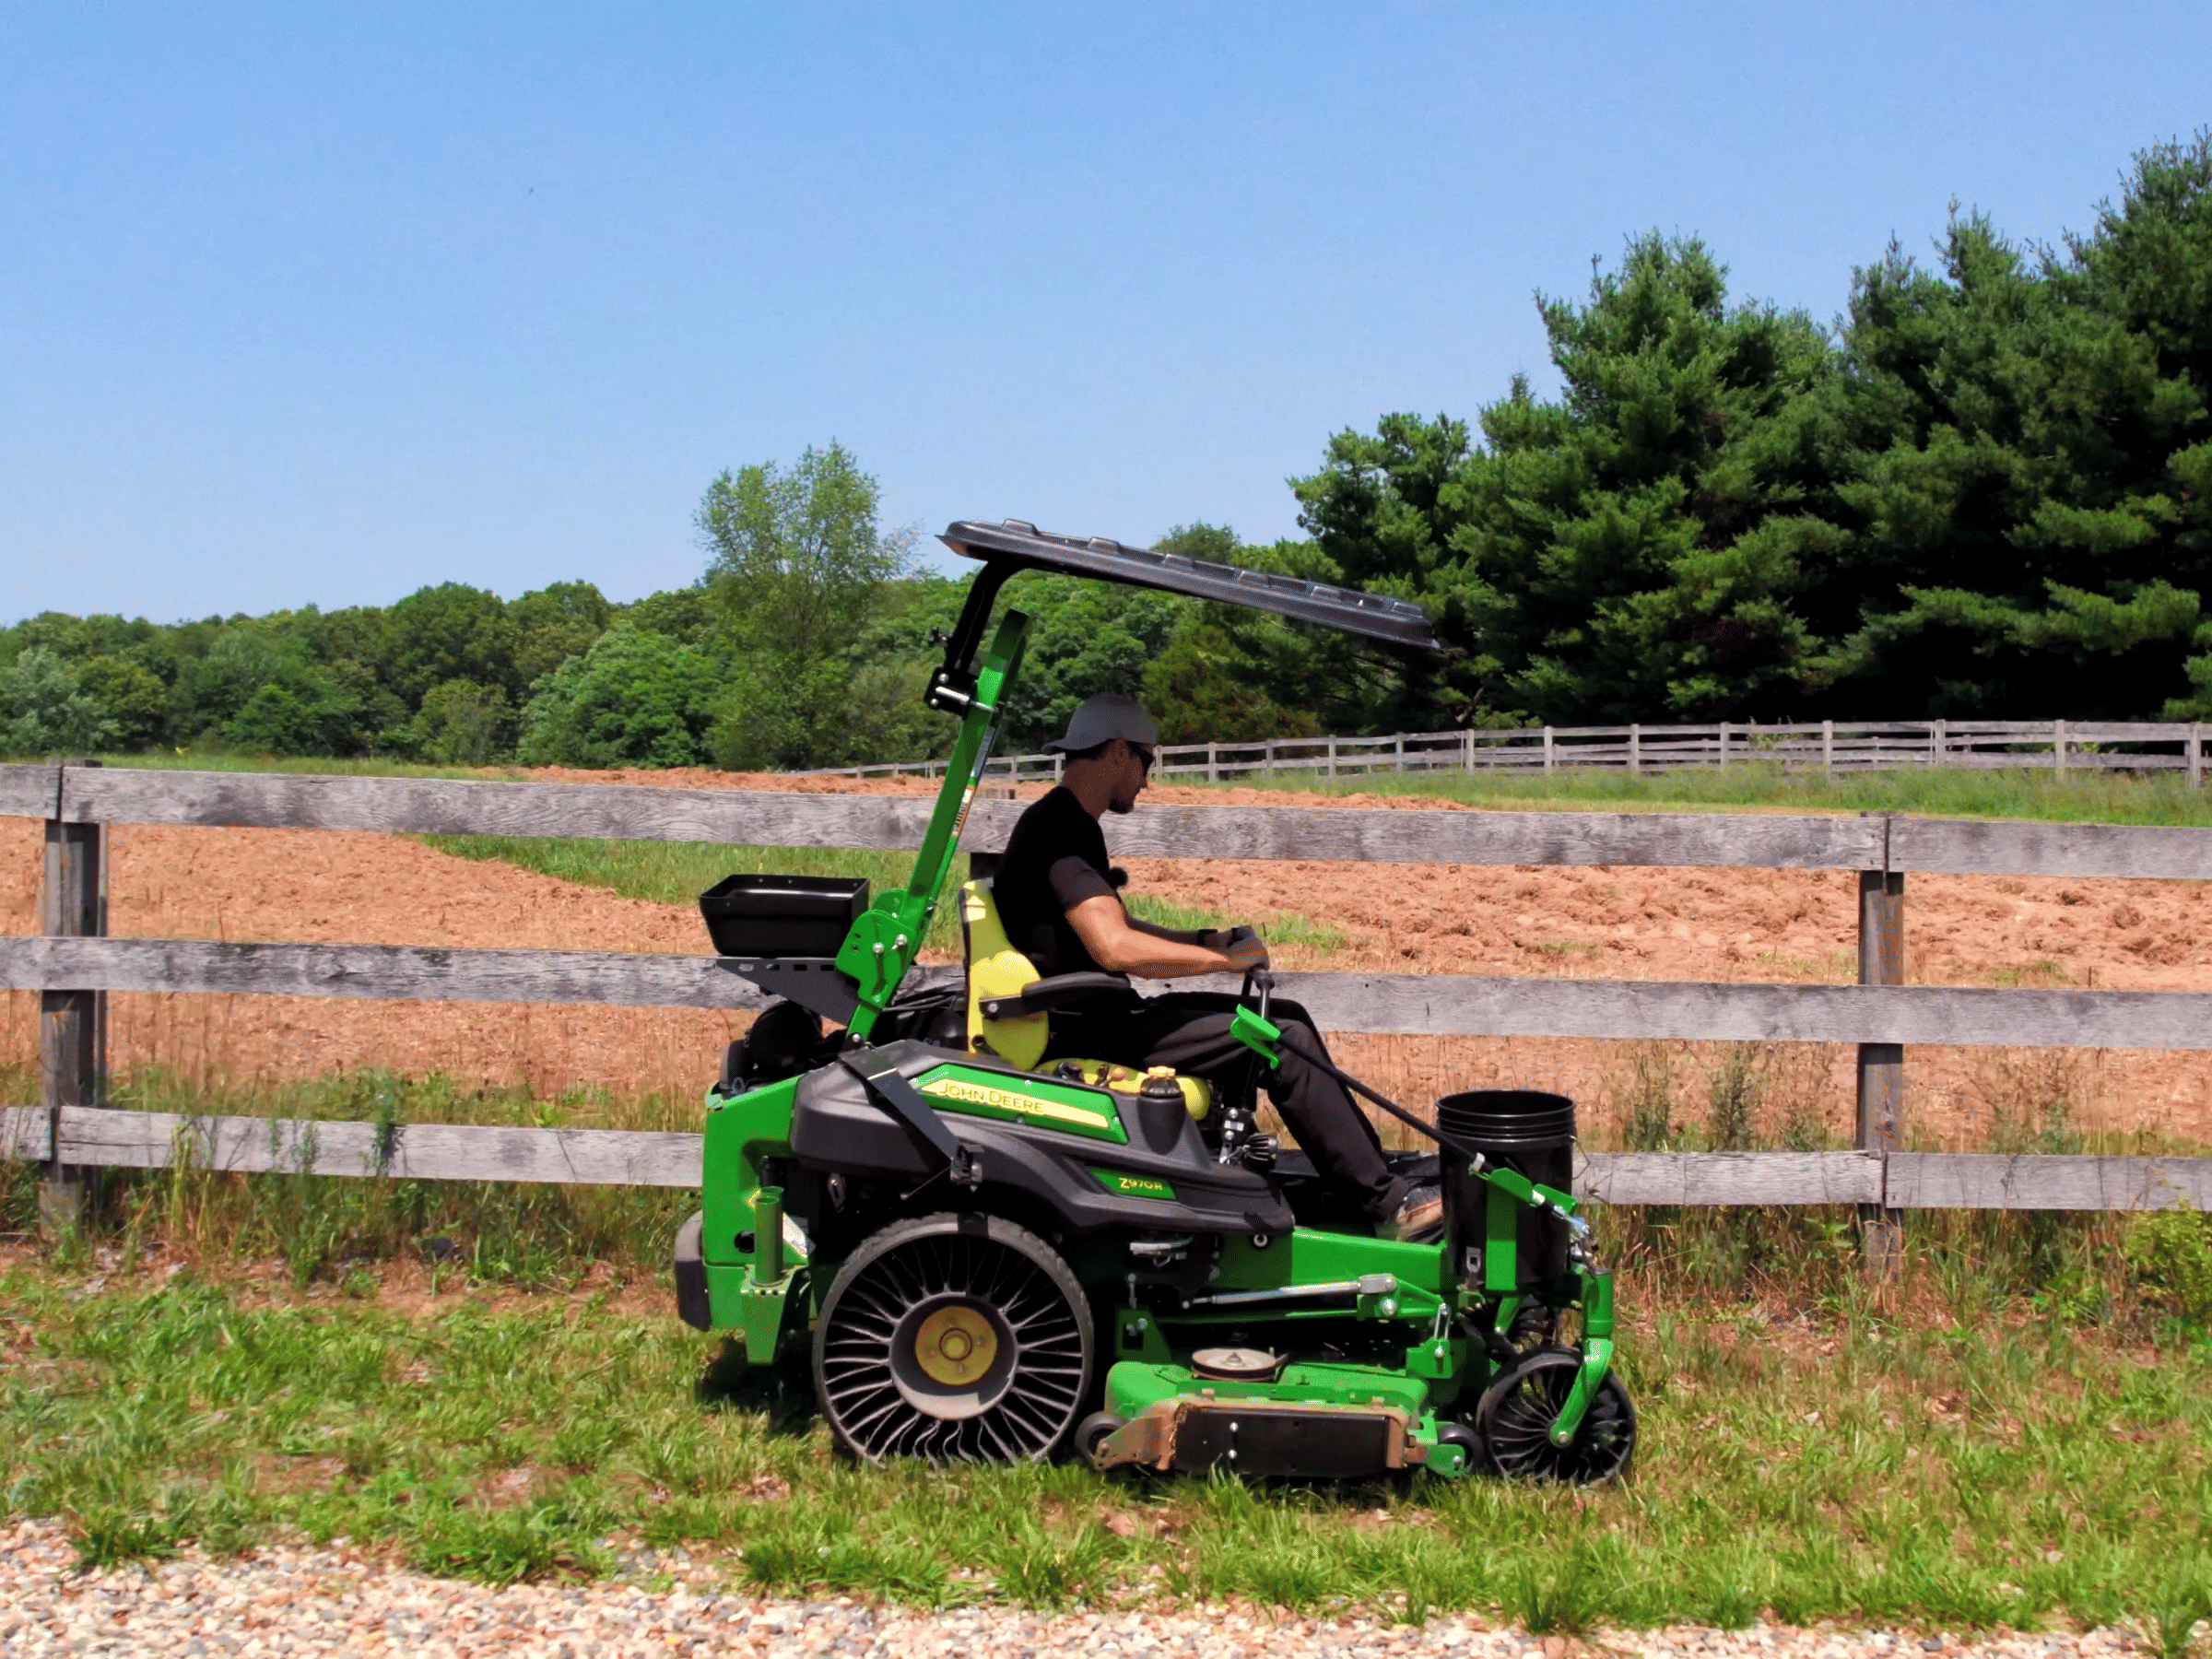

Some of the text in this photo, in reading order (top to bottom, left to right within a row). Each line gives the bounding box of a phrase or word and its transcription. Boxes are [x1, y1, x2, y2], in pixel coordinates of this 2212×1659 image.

[939, 1082, 1043, 1113] JOHN DEERE
[1118, 1177, 1163, 1191] Z970R
